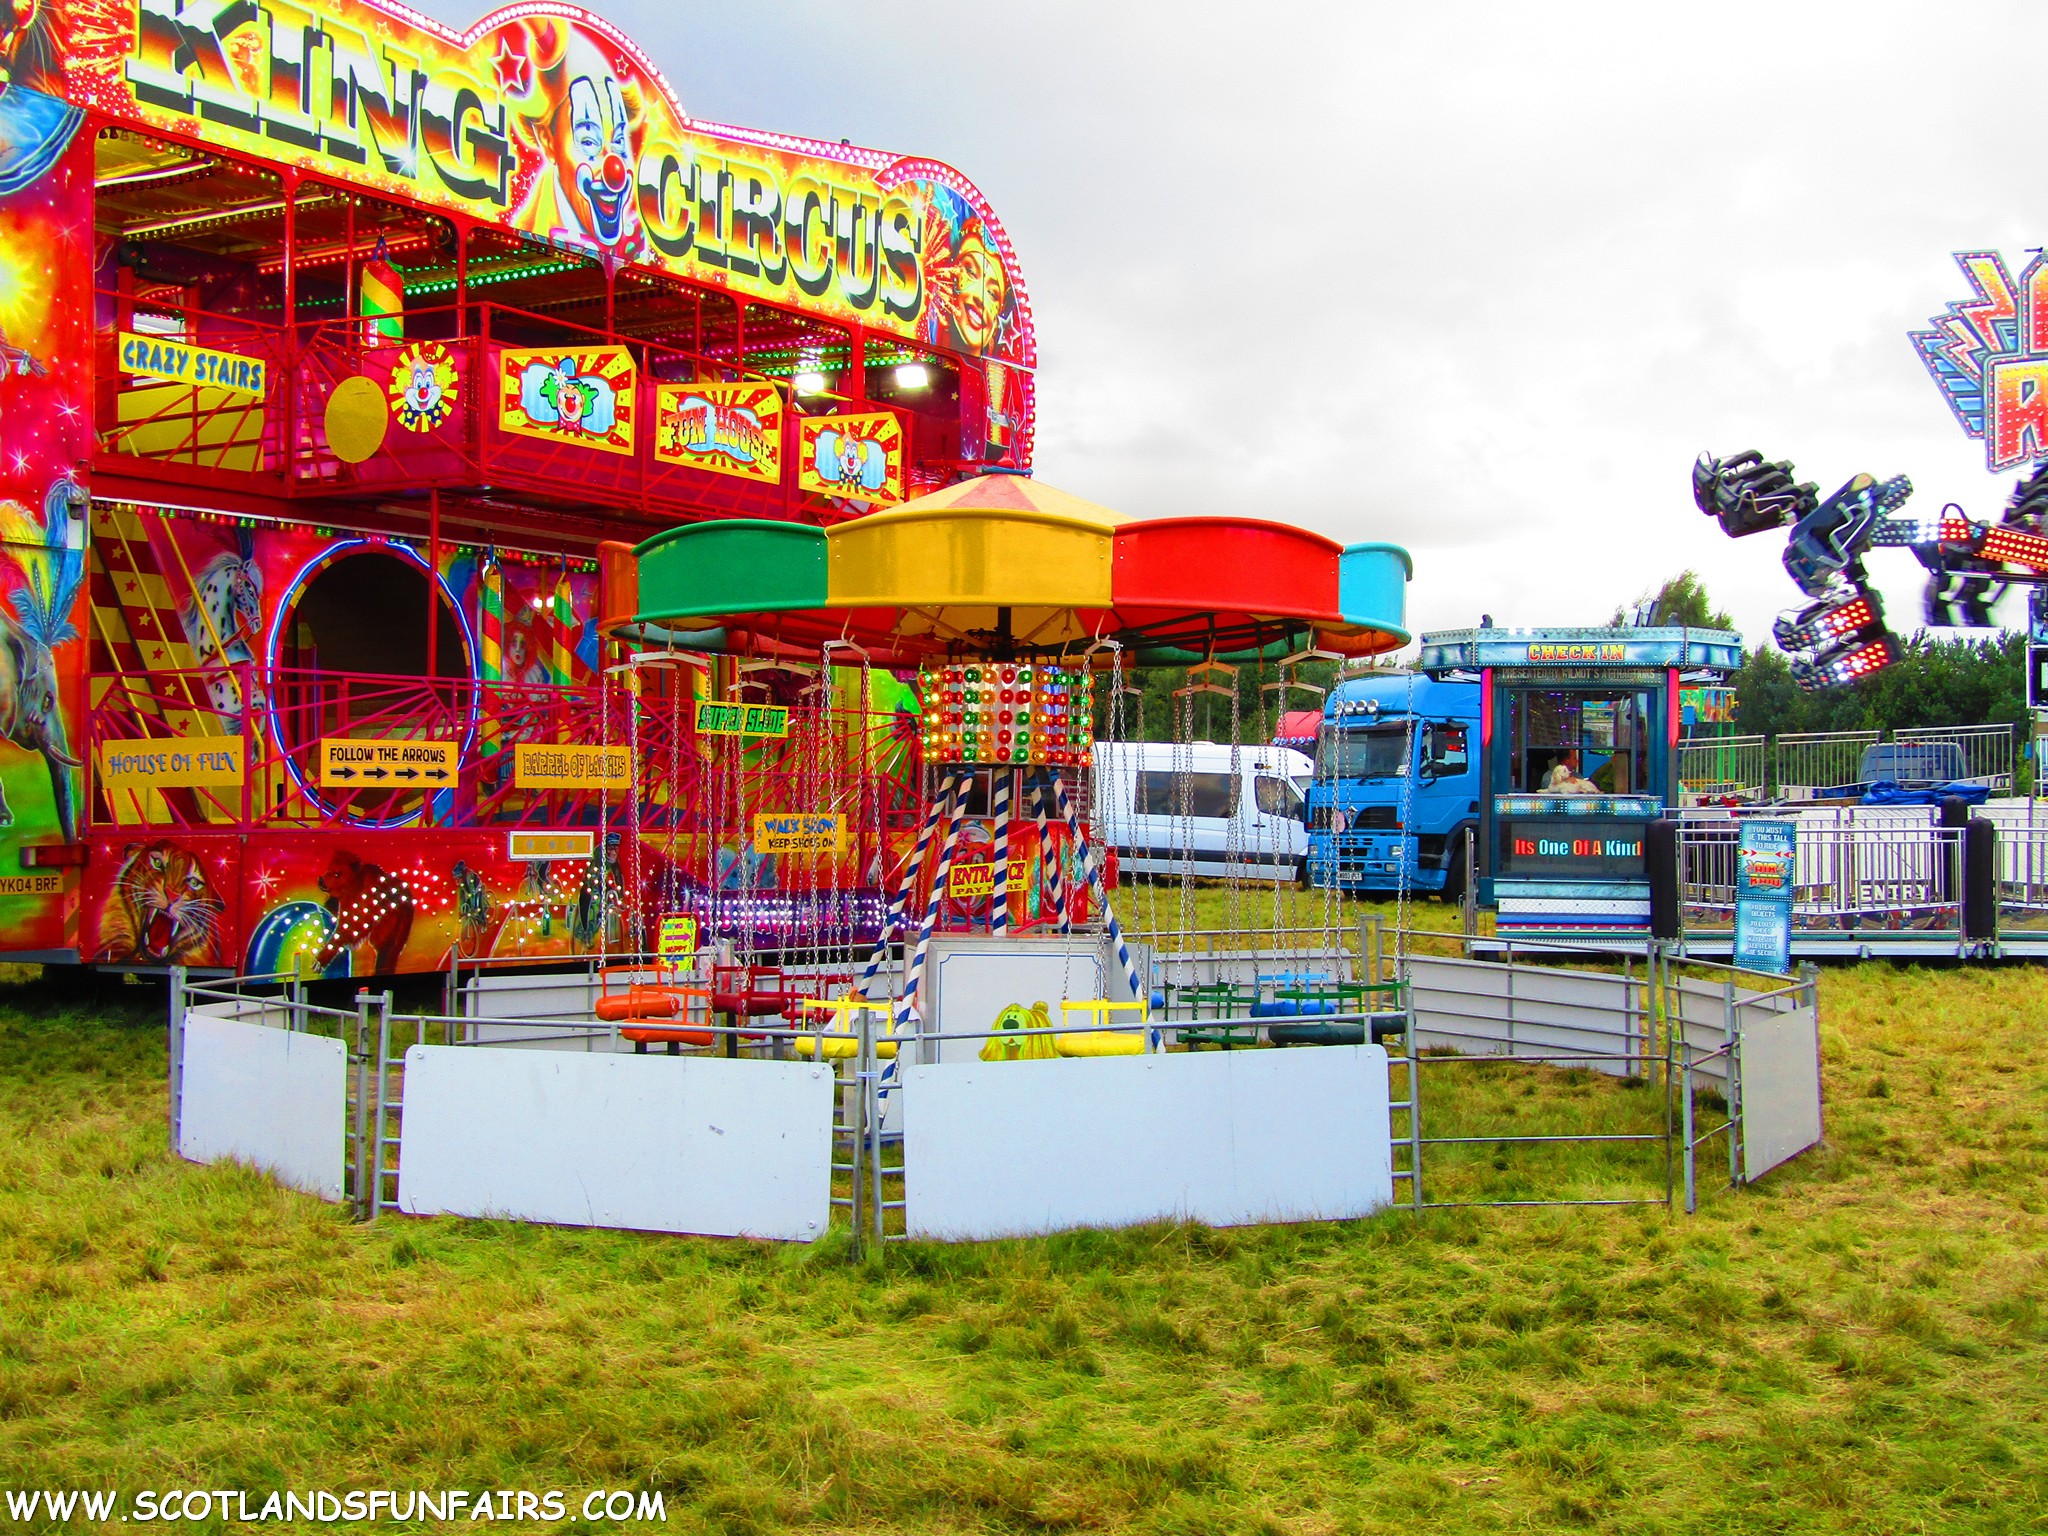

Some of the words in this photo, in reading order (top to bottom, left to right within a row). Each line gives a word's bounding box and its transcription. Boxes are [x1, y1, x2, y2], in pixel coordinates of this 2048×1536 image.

[126, 0, 513, 206] KING
[637, 153, 927, 322] CIRCUS
[123, 339, 190, 377] CRAZY
[194, 353, 262, 391] STAIRS
[665, 405, 708, 450] FUN
[714, 405, 773, 471] HOUSE
[1527, 643, 1597, 662] CHECK
[1600, 643, 1626, 661] IN
[329, 746, 374, 762] FOLLOW
[377, 747, 400, 762] THE
[402, 748, 446, 763] ARROWS
[108, 752, 168, 778] HOUSE
[171, 753, 193, 772] OF
[196, 751, 238, 773] FUN
[523, 752, 570, 779] BARREL
[570, 752, 584, 778] OF
[764, 817, 800, 834] WALK
[1752, 825, 1765, 833] YOU
[1765, 826, 1783, 834] MUST
[768, 837, 790, 849] KEEP
[1514, 838, 1536, 856] Its
[1539, 839, 1569, 856] One
[1573, 839, 1590, 856] Of
[1592, 840, 1602, 856] A
[1605, 839, 1642, 857] Kind
[1755, 842, 1763, 850] TO
[1757, 834, 1772, 842] THIS
[1773, 834, 1788, 843] TALL
[952, 862, 1026, 886] ENTRCE
[0, 878, 32, 892] YK04
[35, 877, 59, 891] BRF
[956, 886, 983, 895] PAY
[987, 883, 1022, 892] HRE
[1860, 884, 1930, 901] ENTRY
